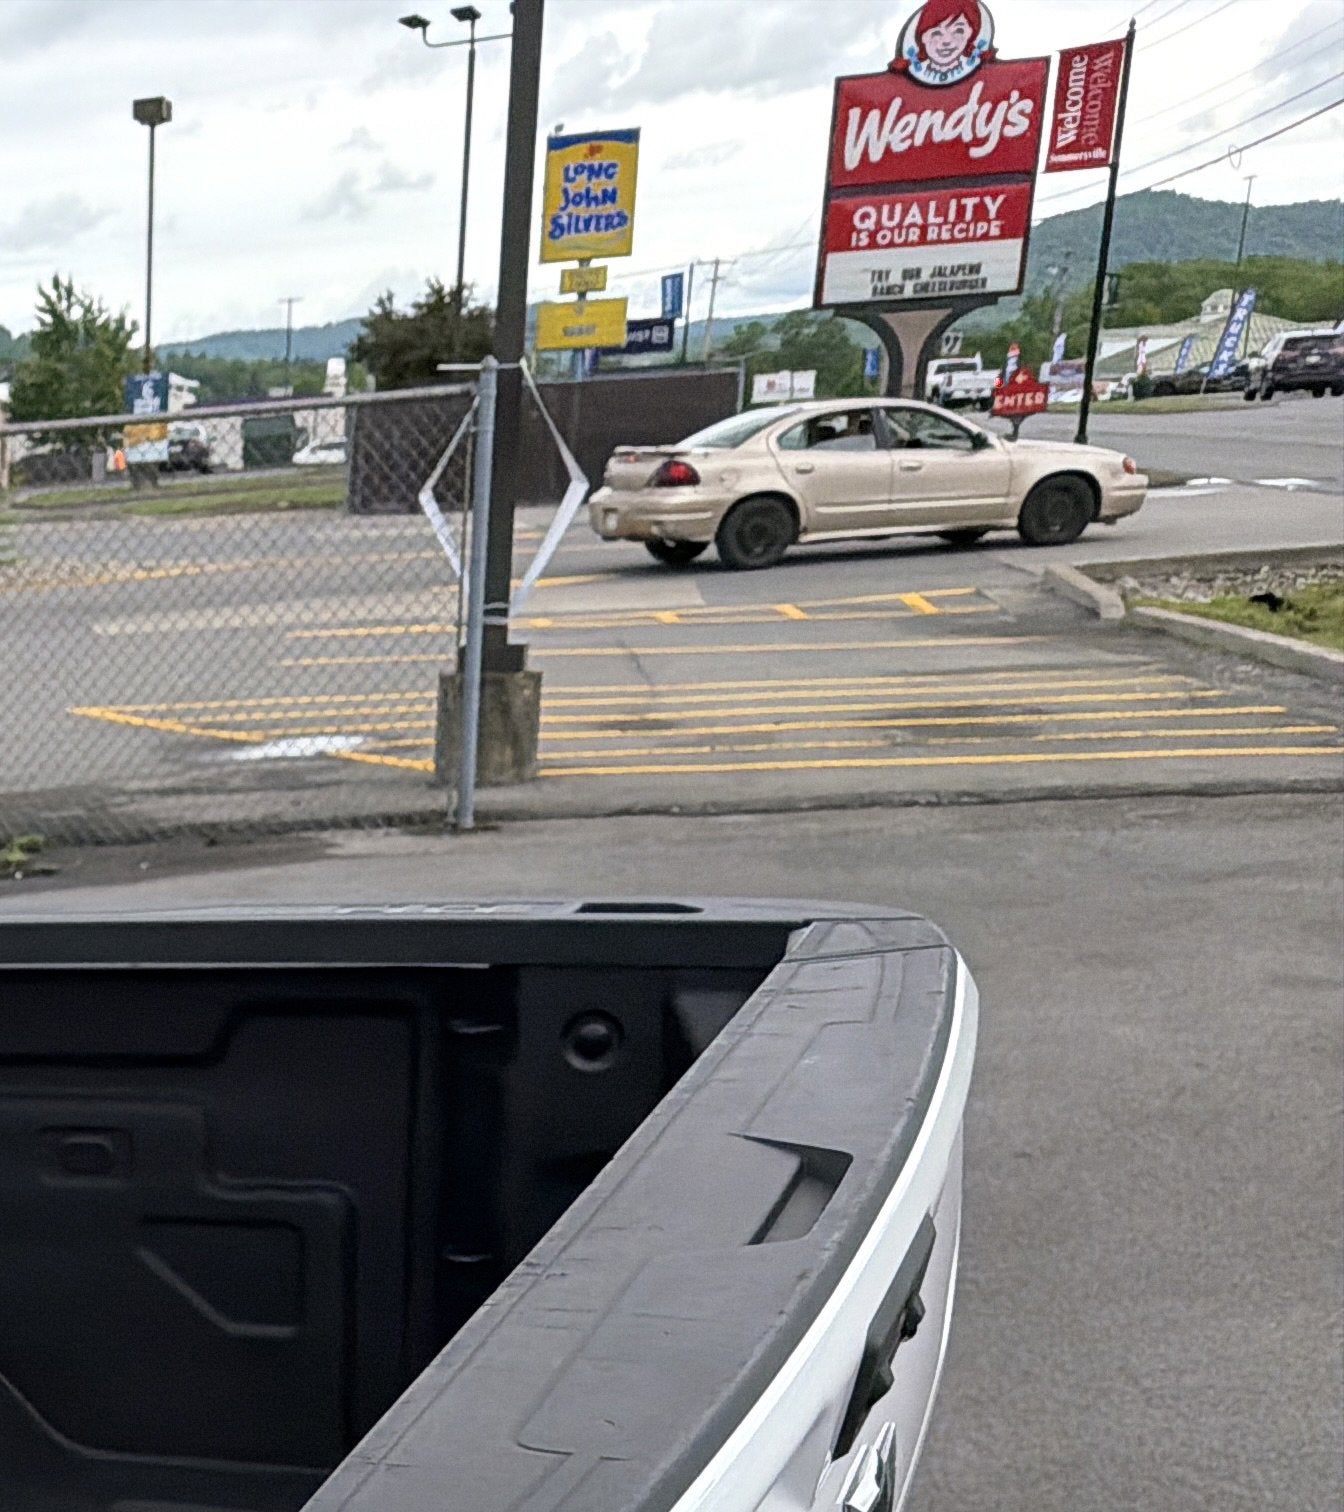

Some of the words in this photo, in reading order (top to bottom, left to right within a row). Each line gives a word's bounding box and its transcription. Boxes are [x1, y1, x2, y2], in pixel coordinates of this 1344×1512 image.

[1055, 54, 1089, 149] Welcome
[844, 80, 1034, 171] Wendy's
[563, 162, 619, 183] LONG
[852, 194, 1007, 231] QUALITY
[850, 231, 870, 248] IS
[876, 226, 920, 247] OUR
[926, 220, 1003, 241] RECIPE
[994, 391, 1045, 409] ENTER
